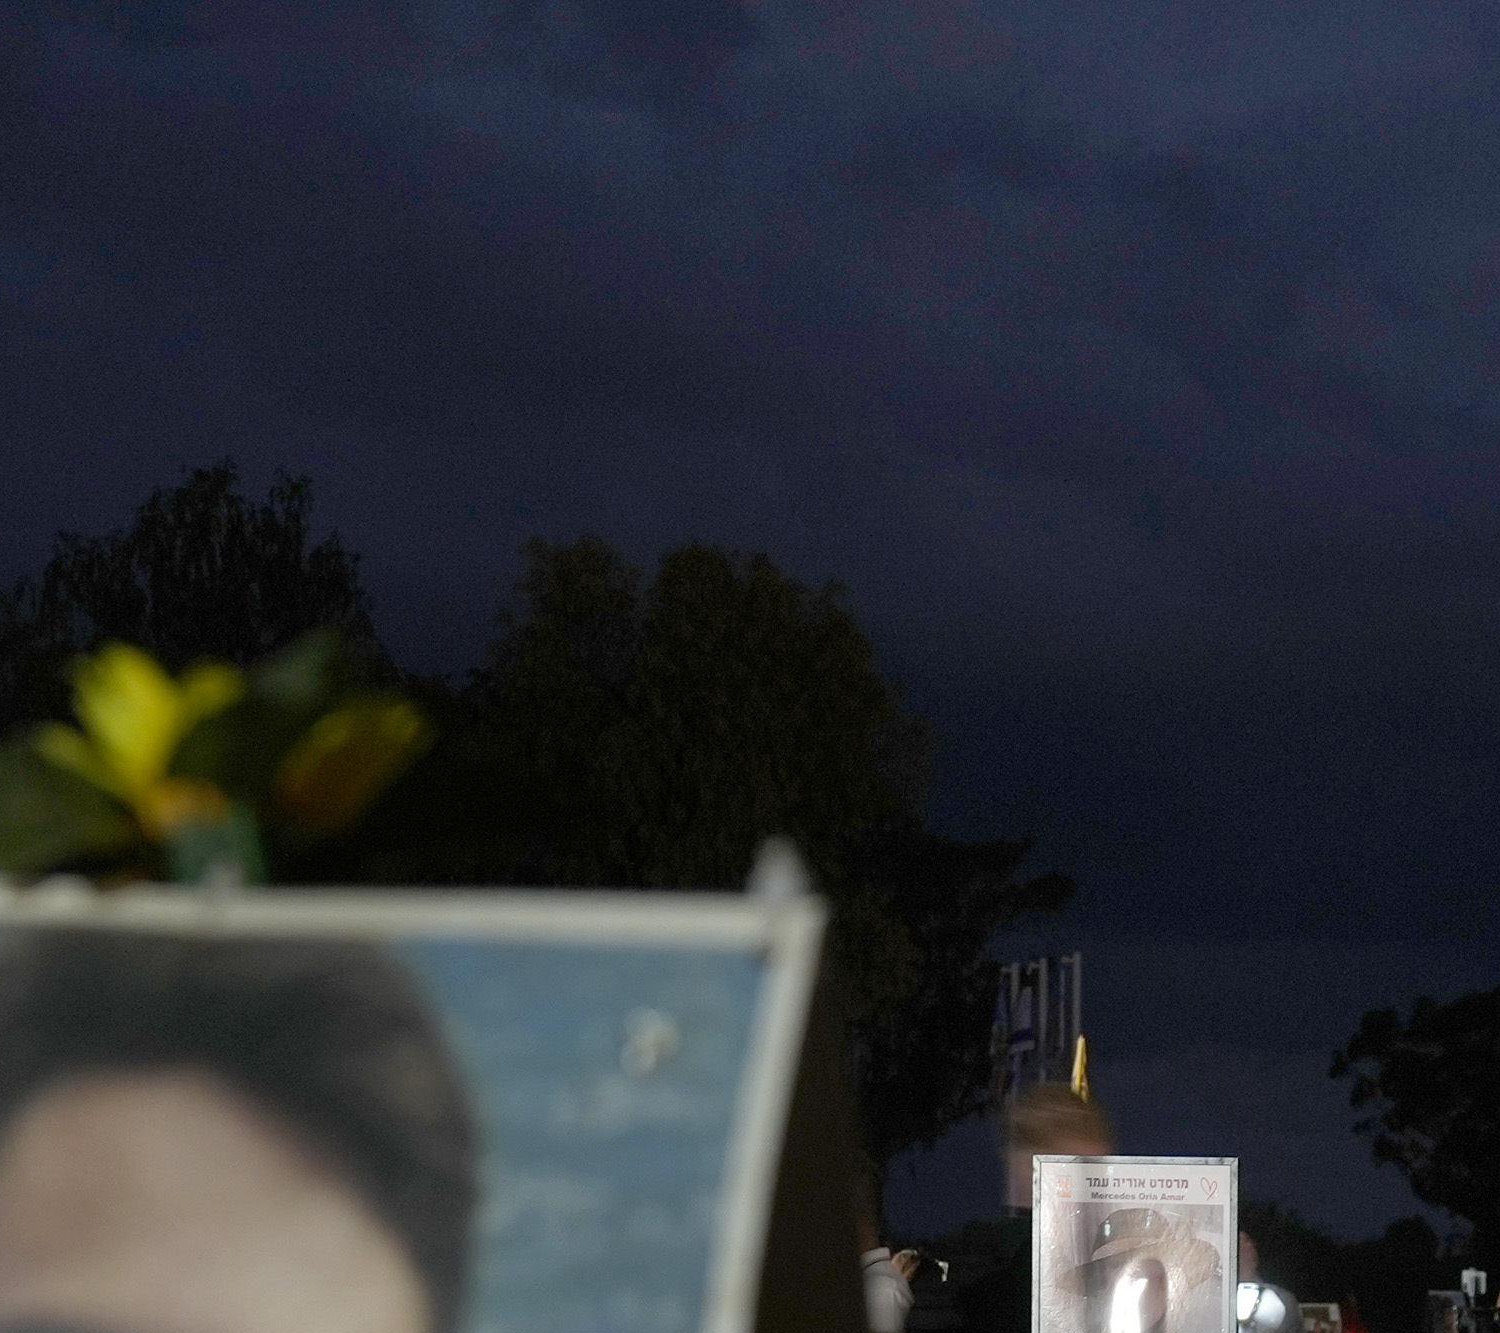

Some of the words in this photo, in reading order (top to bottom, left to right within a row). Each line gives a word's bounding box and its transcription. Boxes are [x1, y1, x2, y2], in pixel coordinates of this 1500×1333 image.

[1085, 1177, 1109, 1189] עמר
[1113, 1177, 1145, 1189] אוריה
[1091, 1192, 1136, 1200] Mercedes
[1139, 1192, 1158, 1200] Oria
[1161, 1193, 1185, 1201] Amar
